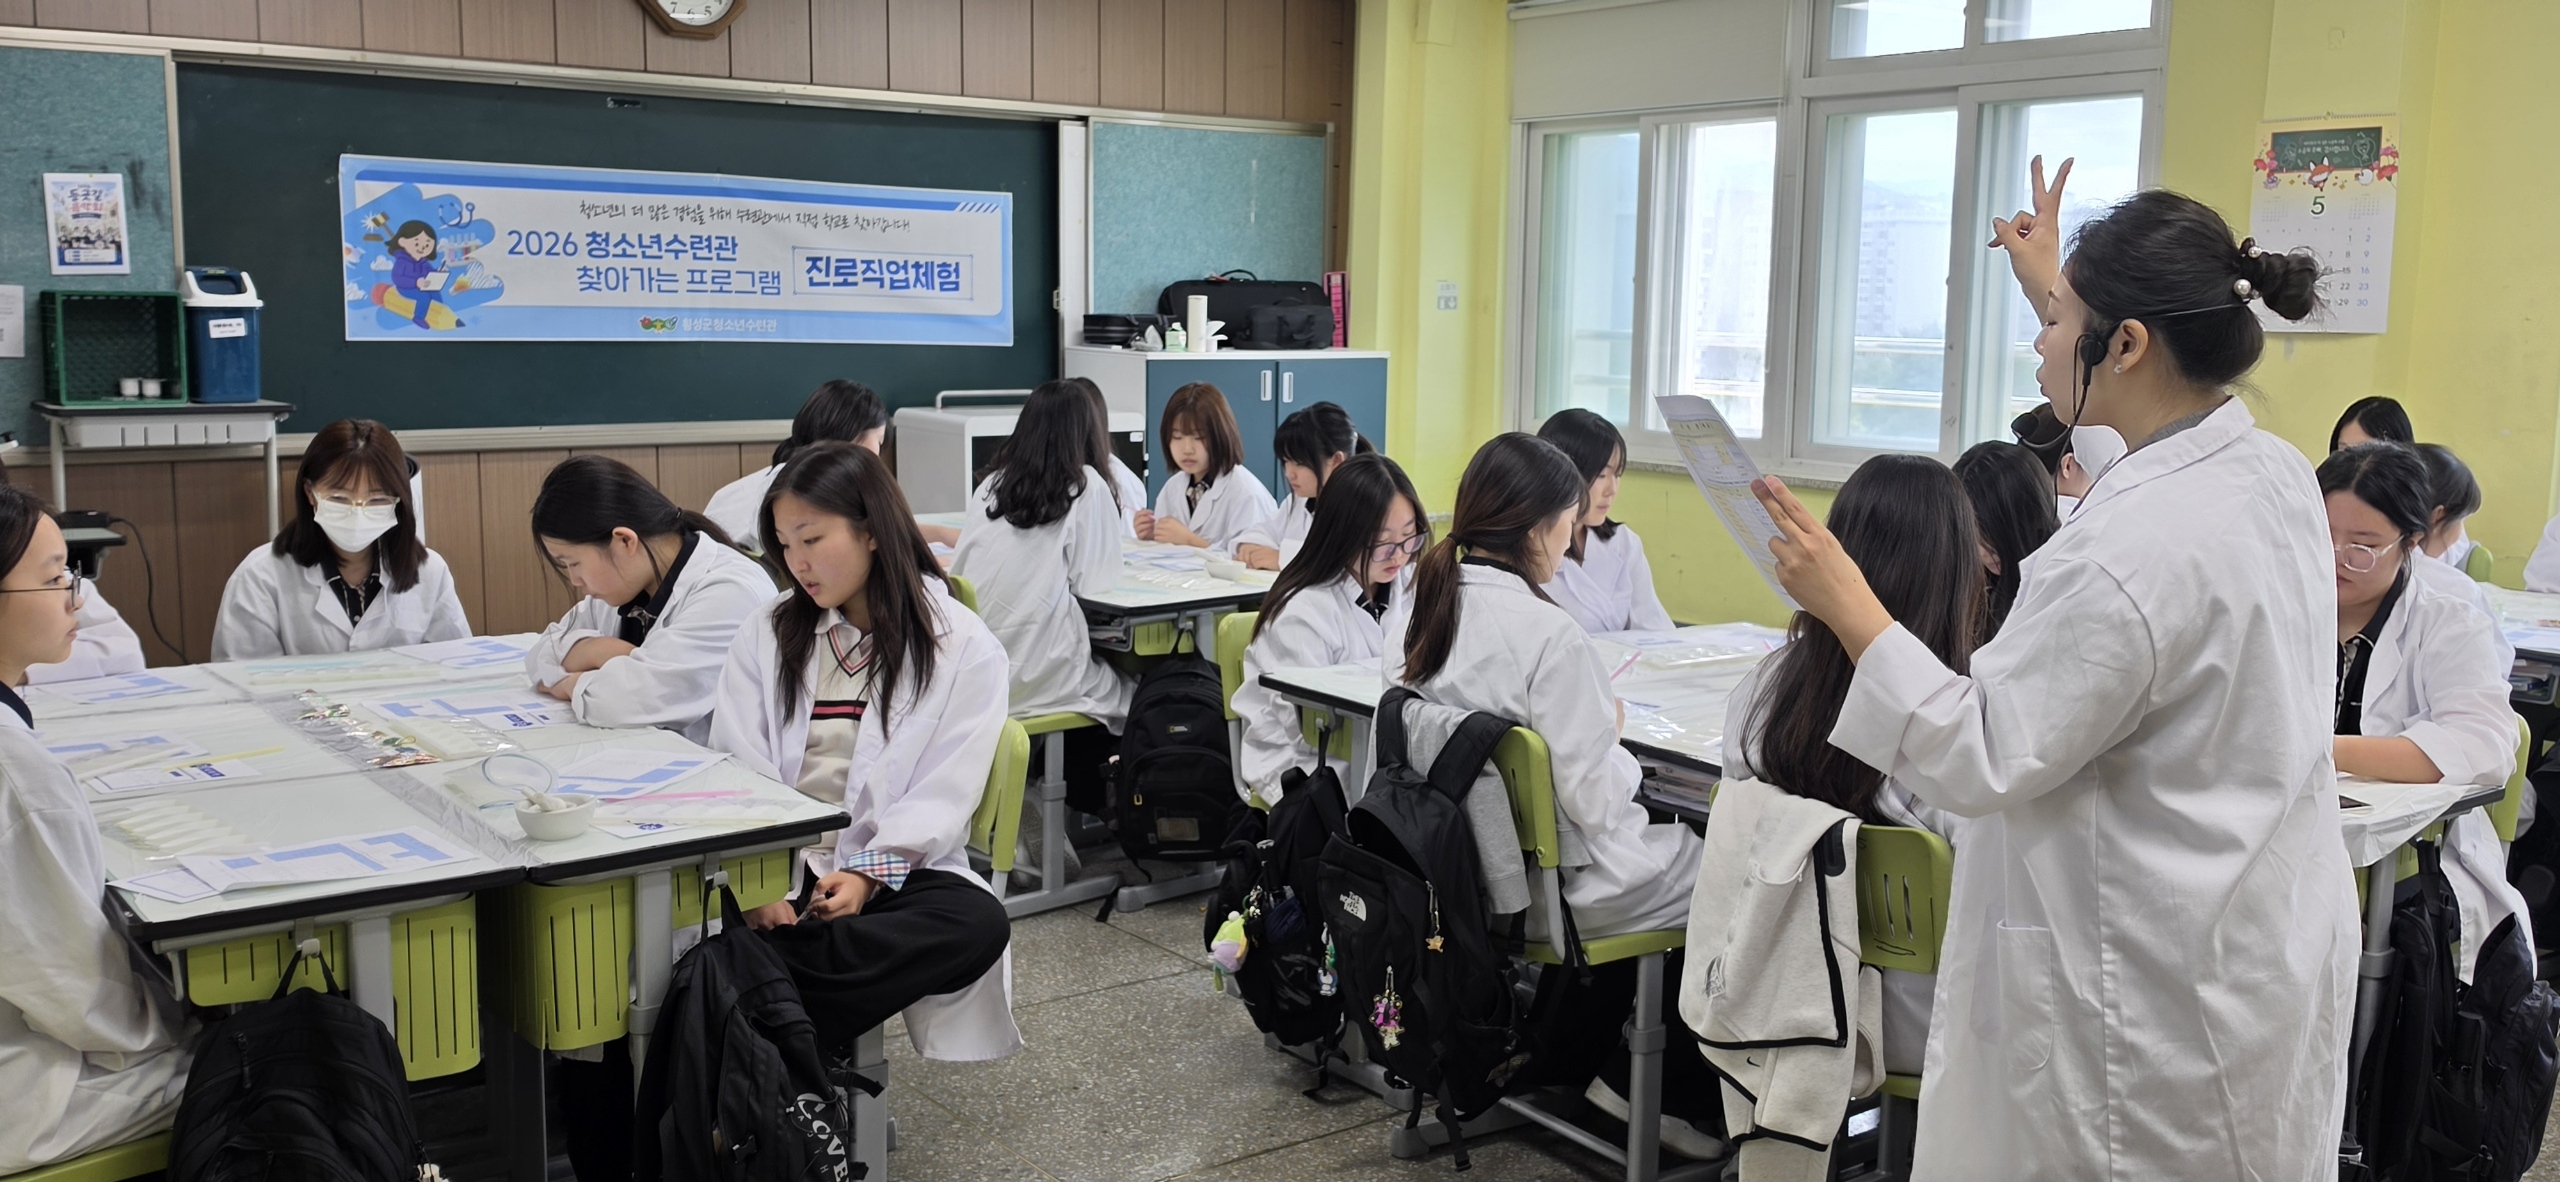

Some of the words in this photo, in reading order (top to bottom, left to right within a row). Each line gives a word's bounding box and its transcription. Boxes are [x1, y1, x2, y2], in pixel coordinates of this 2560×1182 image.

[670, 1, 678, 14] 7
[703, 5, 713, 17] 5
[2310, 195, 2326, 215] 5
[580, 200, 626, 219] 청소년의
[631, 204, 643, 216] 더
[648, 203, 670, 222] 많은
[673, 203, 706, 225] 경험을
[709, 206, 732, 220] 위해
[736, 208, 791, 226] 수련관에서
[795, 212, 819, 230] 직접
[823, 212, 850, 231] 학교로
[507, 229, 579, 257] 2026
[585, 230, 739, 262] 청소년수련관
[2365, 234, 2371, 242] 2
[2364, 250, 2370, 258] 9
[805, 255, 961, 292] 진로직업체험
[2361, 266, 2370, 274] 16
[576, 265, 680, 293] 찾아가는
[686, 268, 782, 296] 프로그램
[2340, 282, 2350, 290] 22
[2358, 282, 2369, 290] 23
[2357, 298, 2368, 306] 30
